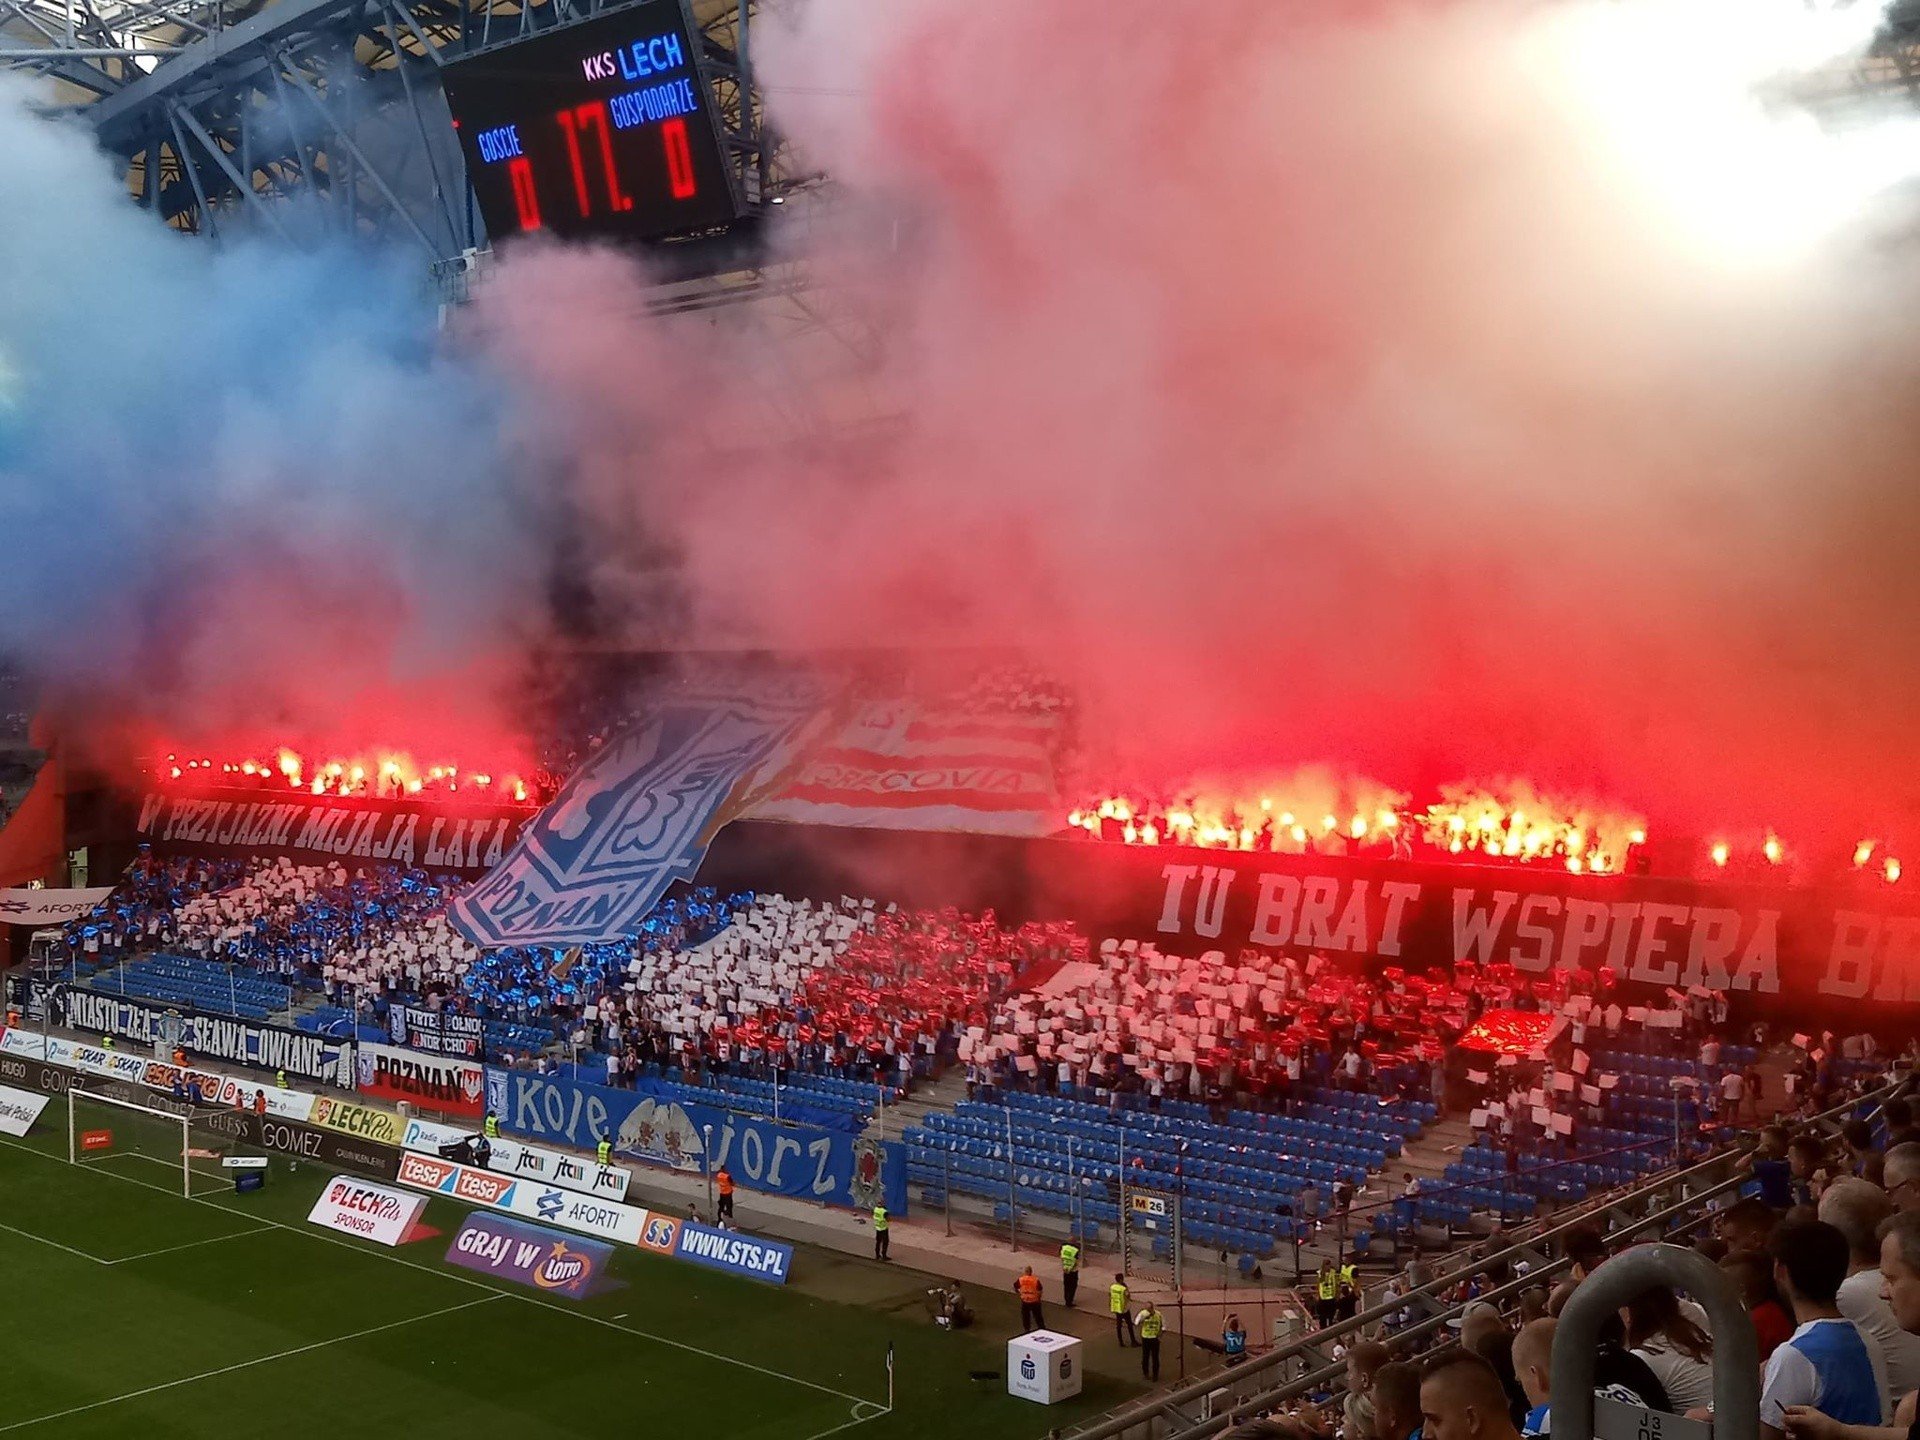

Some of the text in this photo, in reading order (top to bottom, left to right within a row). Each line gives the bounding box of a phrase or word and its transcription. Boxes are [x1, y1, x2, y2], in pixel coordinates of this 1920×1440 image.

[583, 33, 683, 81] KKS LECH
[611, 79, 697, 129] GOSPODARZE
[661, 118, 696, 198] 0
[509, 157, 541, 231] 0
[1157, 864, 1236, 938] TU
[1249, 873, 1421, 955] BRAT
[1453, 888, 1781, 993] WSPIERA
[69, 991, 119, 1034] MIASTO
[258, 1029, 324, 1078] OWIANE
[1, 1060, 26, 1078] HUGO
[376, 1054, 463, 1103] POZNAŃ
[208, 1113, 249, 1137] GUESS
[327, 1103, 372, 1135] LECH
[263, 1123, 323, 1158] GOMEZ
[404, 1159, 439, 1184] tesa
[460, 1174, 498, 1201] tesa
[338, 1187, 384, 1215] LECH
[569, 1203, 620, 1229] AFORTI
[1135, 1199, 1162, 1212] M 26
[334, 1212, 375, 1234] SPONSOR
[457, 1228, 541, 1269] GRAJ W
[682, 1228, 783, 1276] WWW.STS.PL
[545, 1259, 581, 1281] LOTTO
